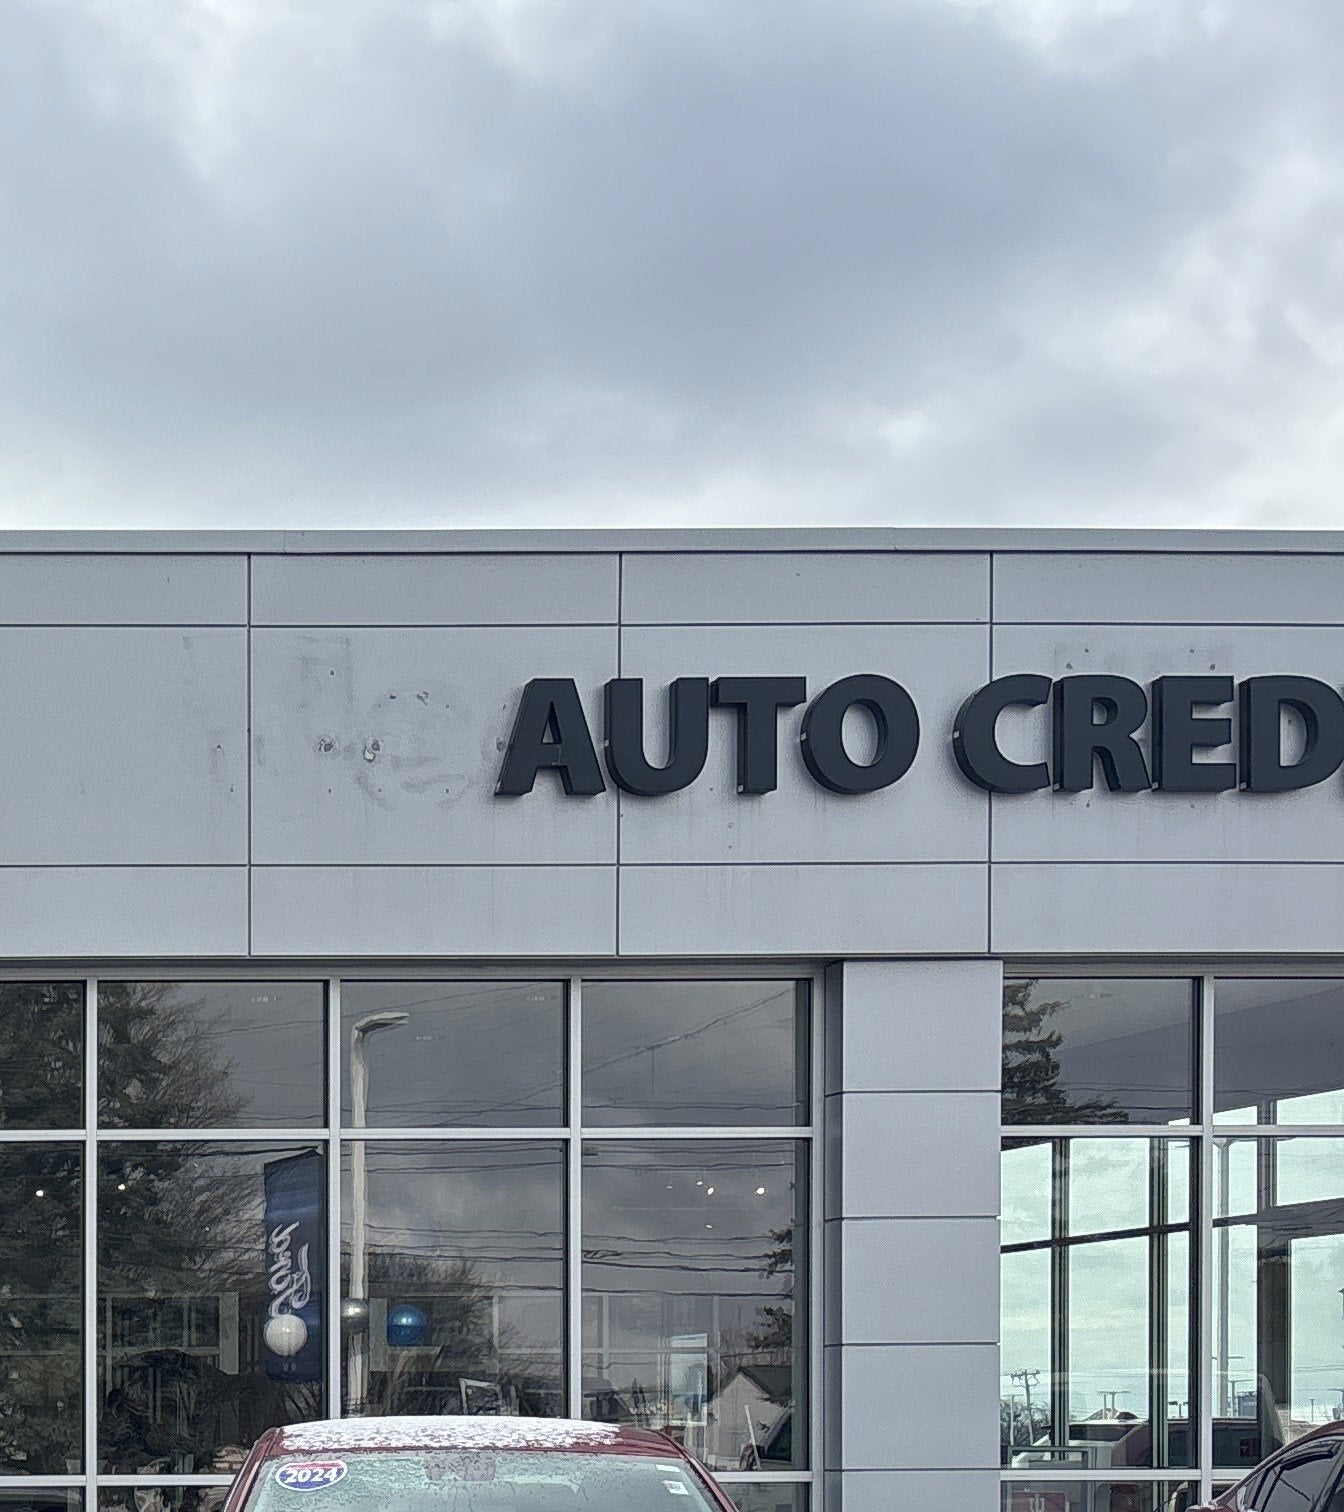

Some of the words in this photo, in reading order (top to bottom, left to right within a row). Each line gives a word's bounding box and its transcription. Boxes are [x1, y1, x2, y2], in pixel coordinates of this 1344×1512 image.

[493, 673, 921, 797] AUTO
[951, 673, 1344, 793] CRED
[284, 1467, 338, 1483] 2024
